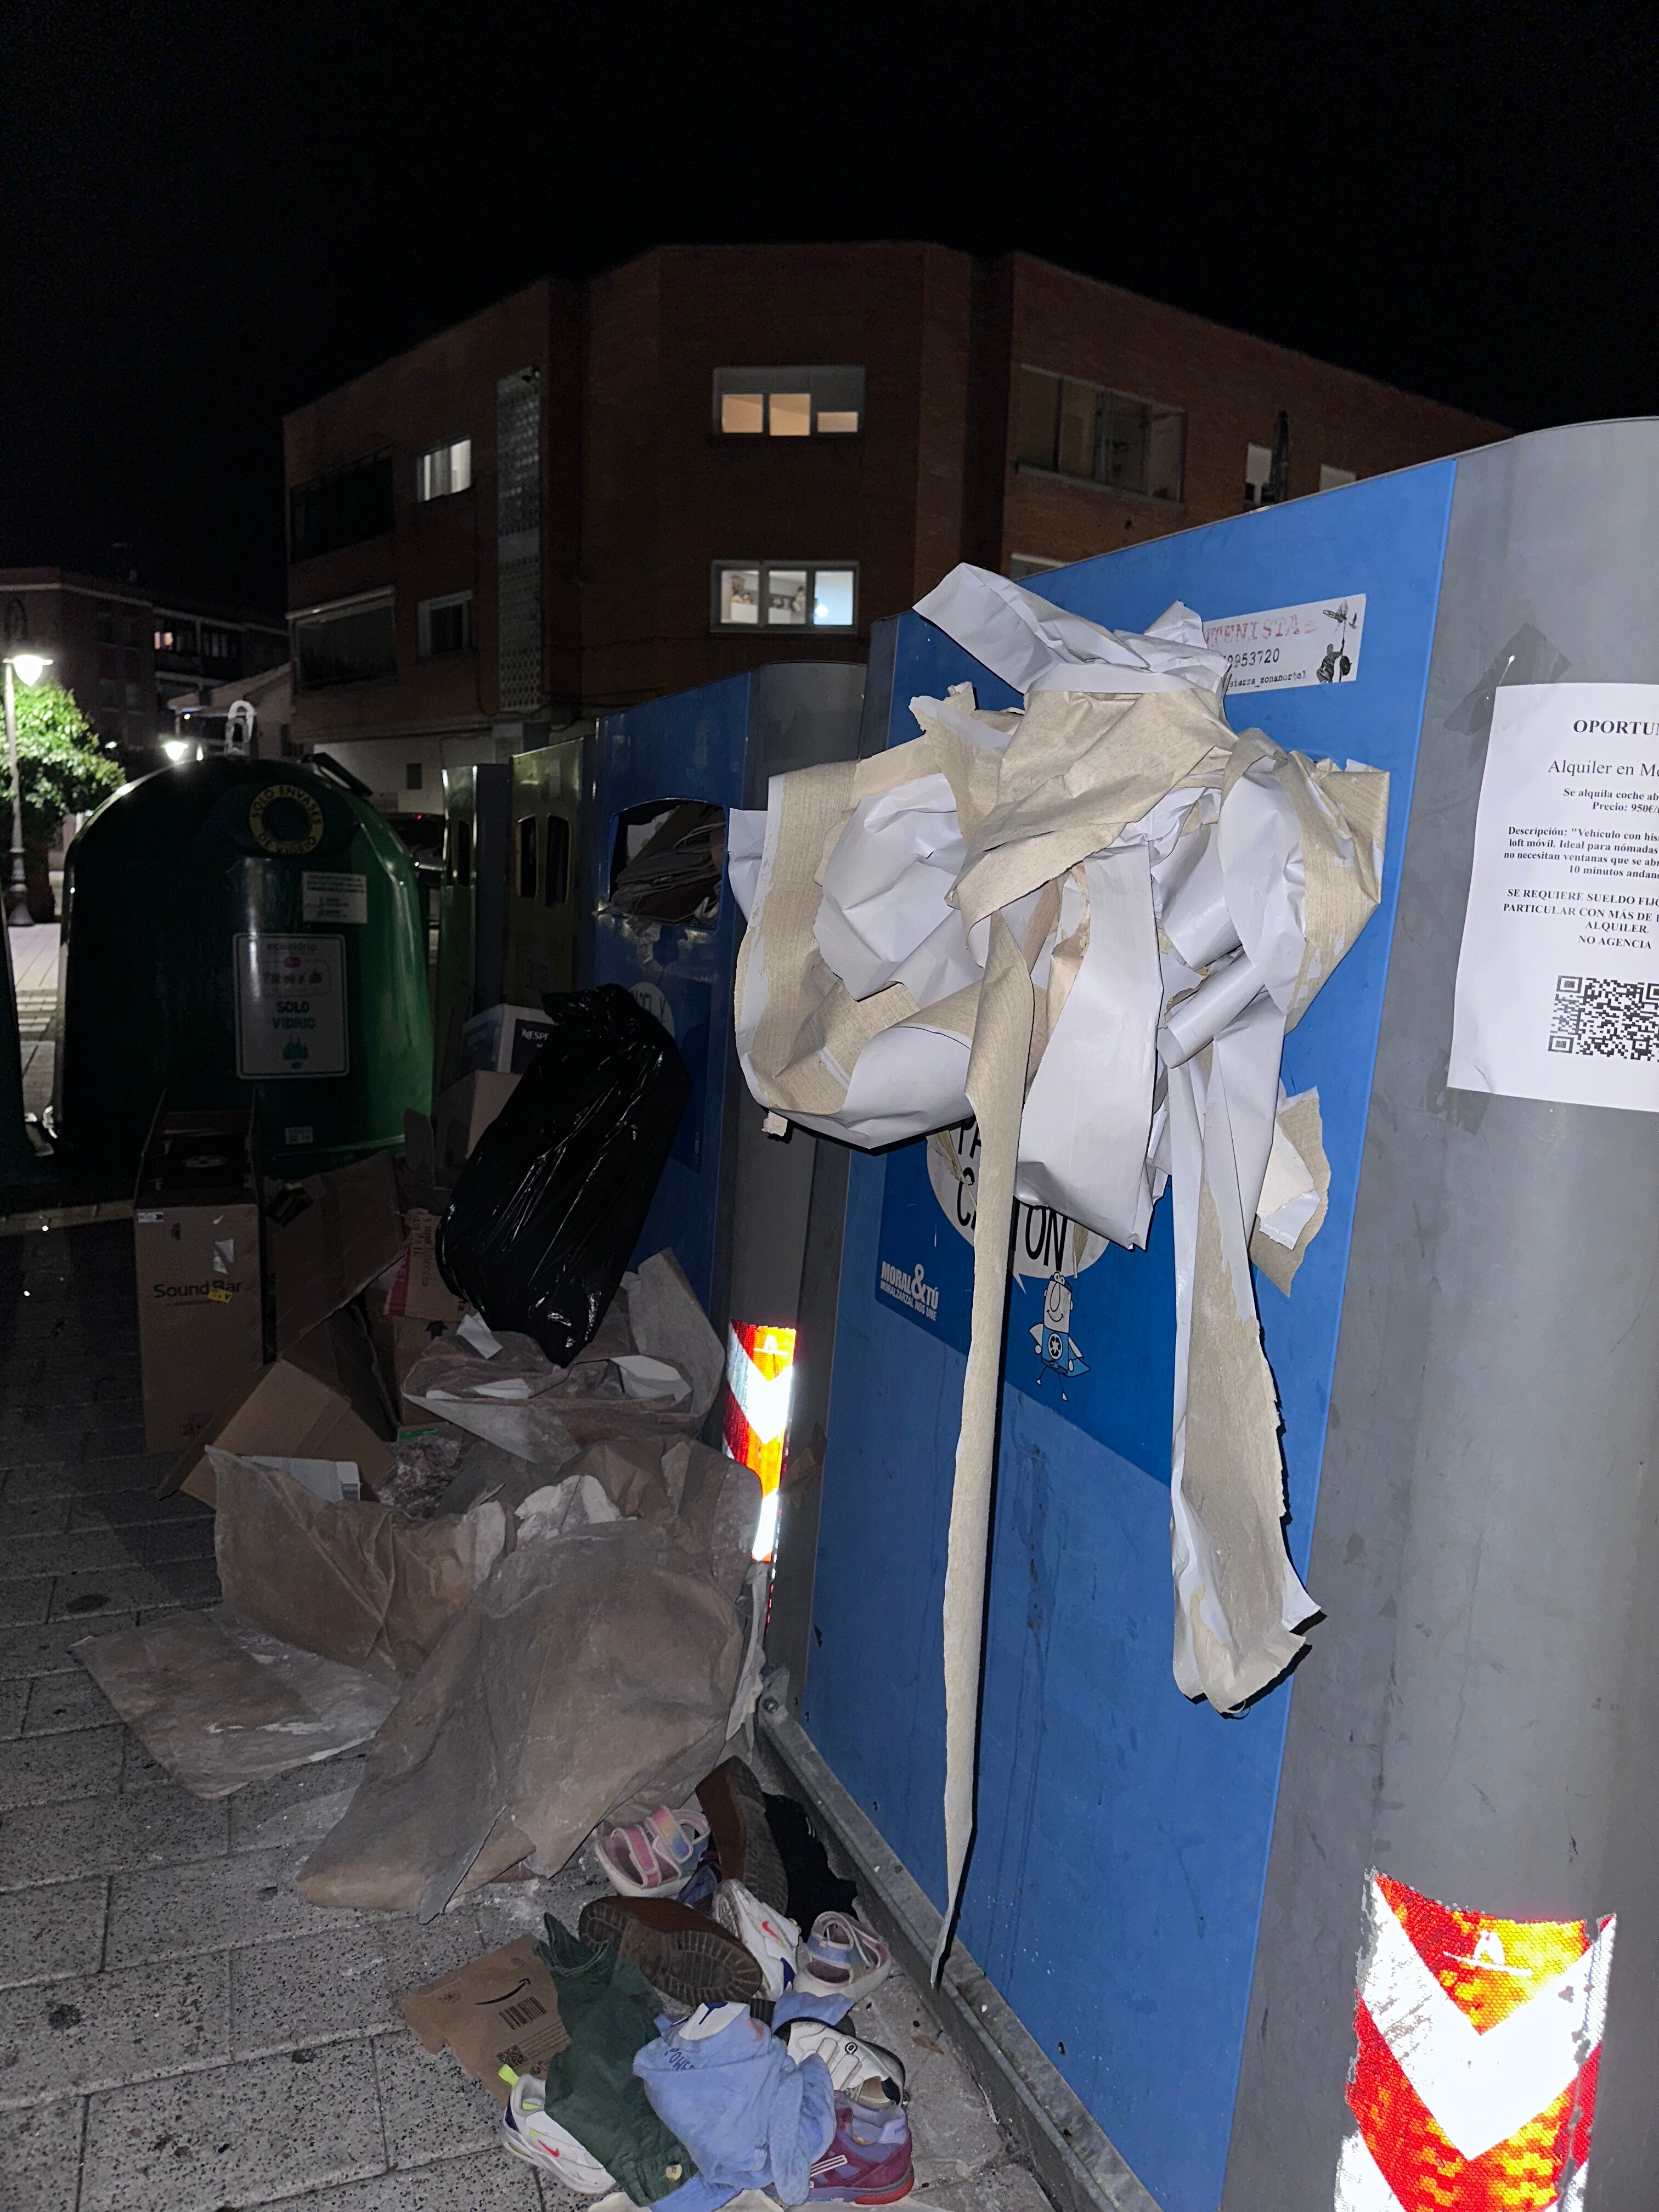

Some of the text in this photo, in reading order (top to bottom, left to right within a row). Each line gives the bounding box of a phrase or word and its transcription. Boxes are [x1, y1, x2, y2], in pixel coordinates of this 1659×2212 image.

[1547, 759, 1659, 777] Alquiler en M
[1563, 787, 1576, 797] Se
[1578, 789, 1612, 799] alquila
[1616, 791, 1644, 800] coche
[1592, 802, 1628, 811] Precio:
[1508, 826, 1659, 842] Descripción: "Vehículo con his
[1509, 838, 1524, 847] loft
[1527, 839, 1556, 848] móvil.
[1560, 840, 1584, 849] Ideal
[1614, 843, 1658, 855] nómadas
[1517, 851, 1560, 860] necesitan
[1564, 854, 1607, 863] ventanas
[1611, 857, 1629, 866] que
[1569, 865, 1581, 873] 10
[1583, 866, 1624, 877] minutos
[1507, 889, 1521, 898] SE
[1523, 889, 1584, 901] REQUIERE
[1587, 893, 1635, 905] SUELDO
[1503, 904, 1652, 922] PARTICULAR CON MÁS DE
[1578, 935, 1652, 949] NO AGENCIA
[276, 1000, 310, 1013] SOLO
[272, 1017, 316, 1030] VIDRIO
[153, 1281, 210, 1298] Sound
[879, 1279, 938, 1322] MORALZARZAL NOS UNE
